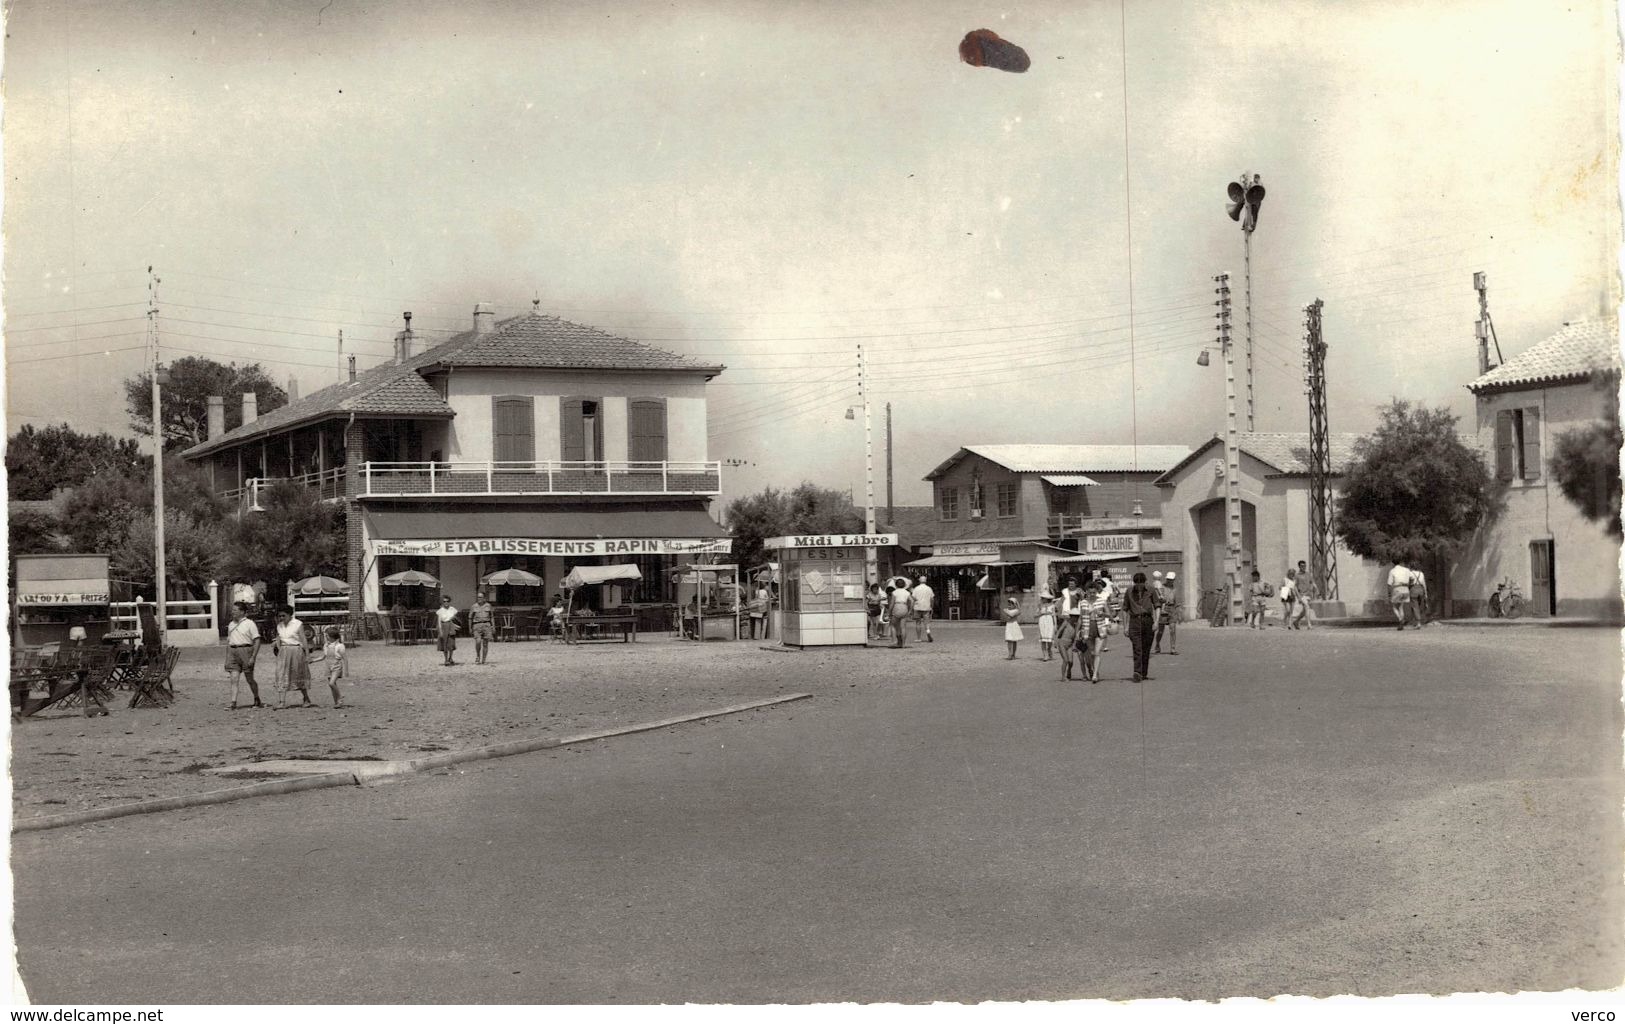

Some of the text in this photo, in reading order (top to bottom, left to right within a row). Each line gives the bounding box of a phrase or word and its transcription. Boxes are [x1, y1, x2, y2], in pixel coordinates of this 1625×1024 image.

[445, 540, 658, 553] ETABLISSEMENTS RAPIN
[794, 535, 889, 547] Midi Libre
[1091, 537, 1134, 550] LIBRAIRIE
[80, 594, 108, 602] FRITES
